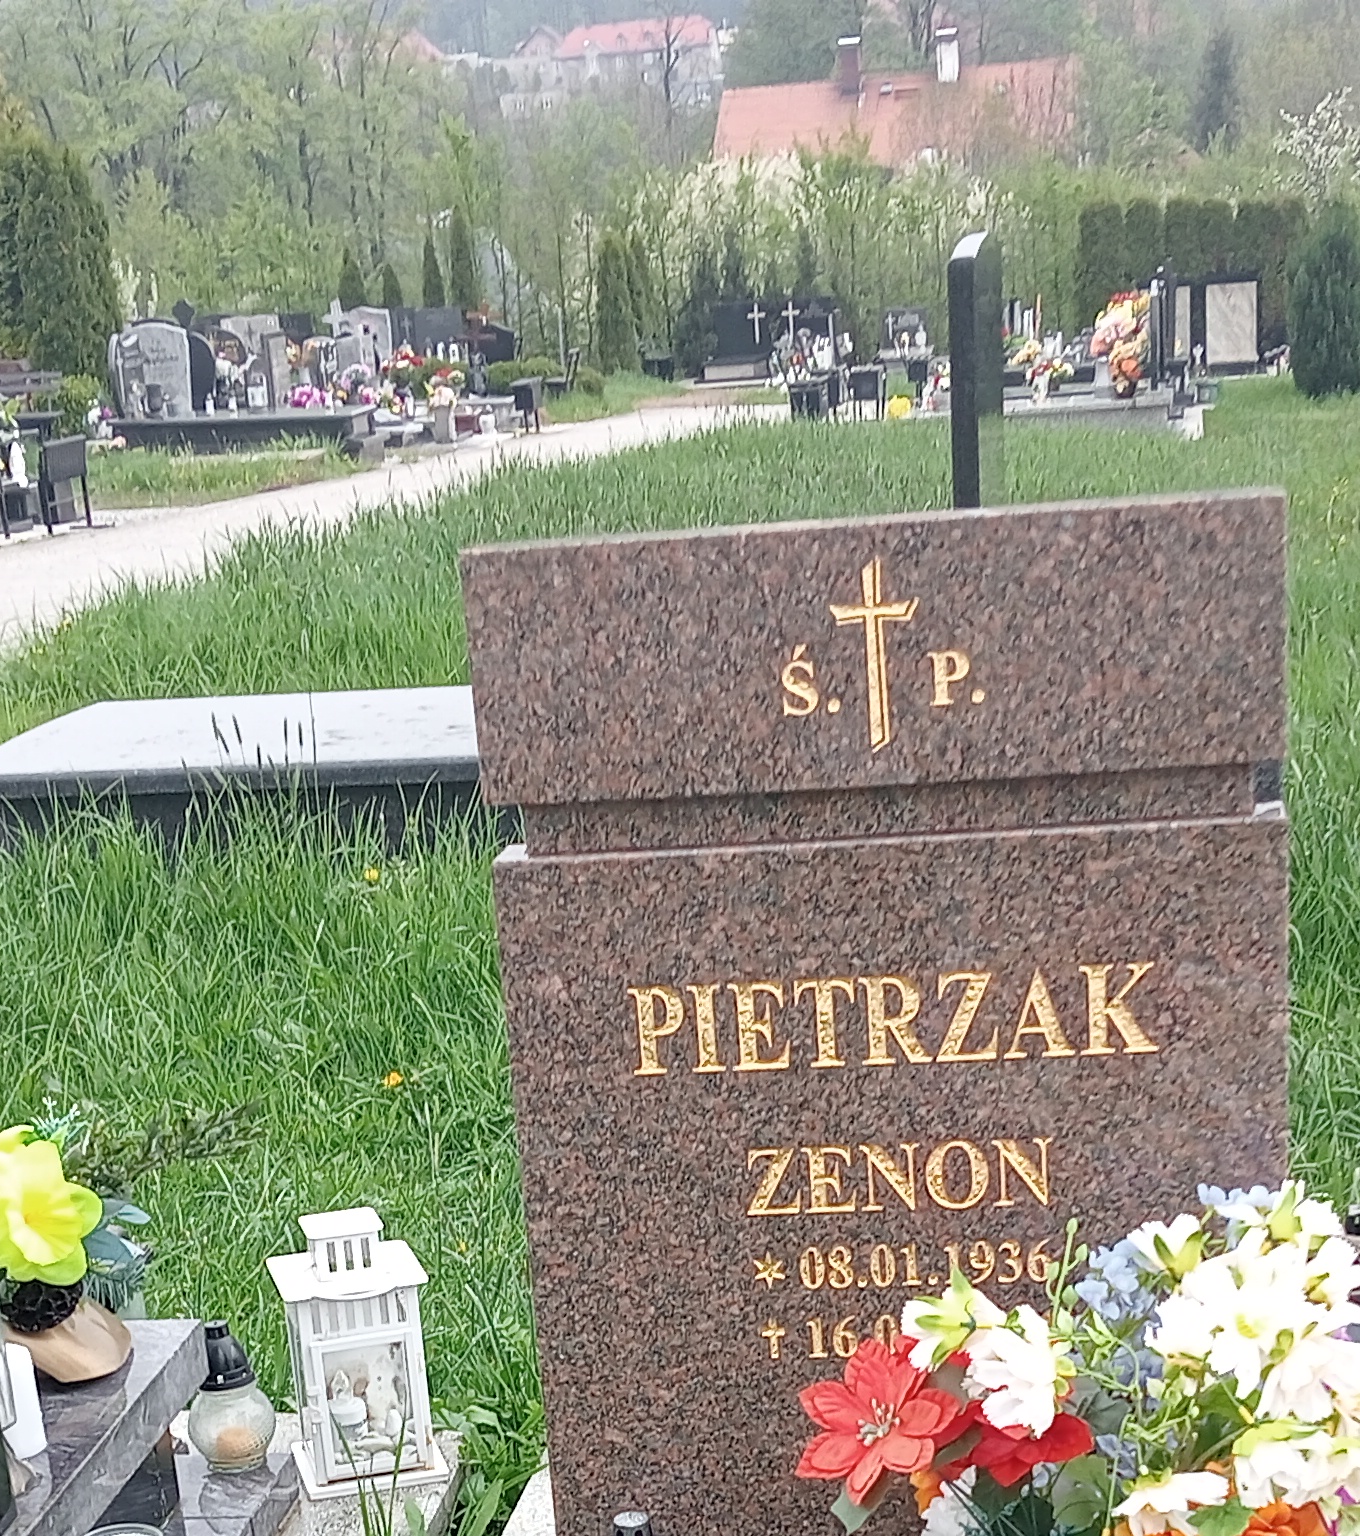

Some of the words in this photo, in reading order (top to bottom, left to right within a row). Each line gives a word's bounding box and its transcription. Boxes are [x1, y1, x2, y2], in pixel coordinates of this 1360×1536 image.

[781, 645, 841, 717] Ś.
[927, 649, 987, 708] P.
[627, 960, 1160, 1076] PIETRZAK
[746, 1136, 1053, 1218] ZENON
[799, 1238, 1053, 1290] 08.01.1936
